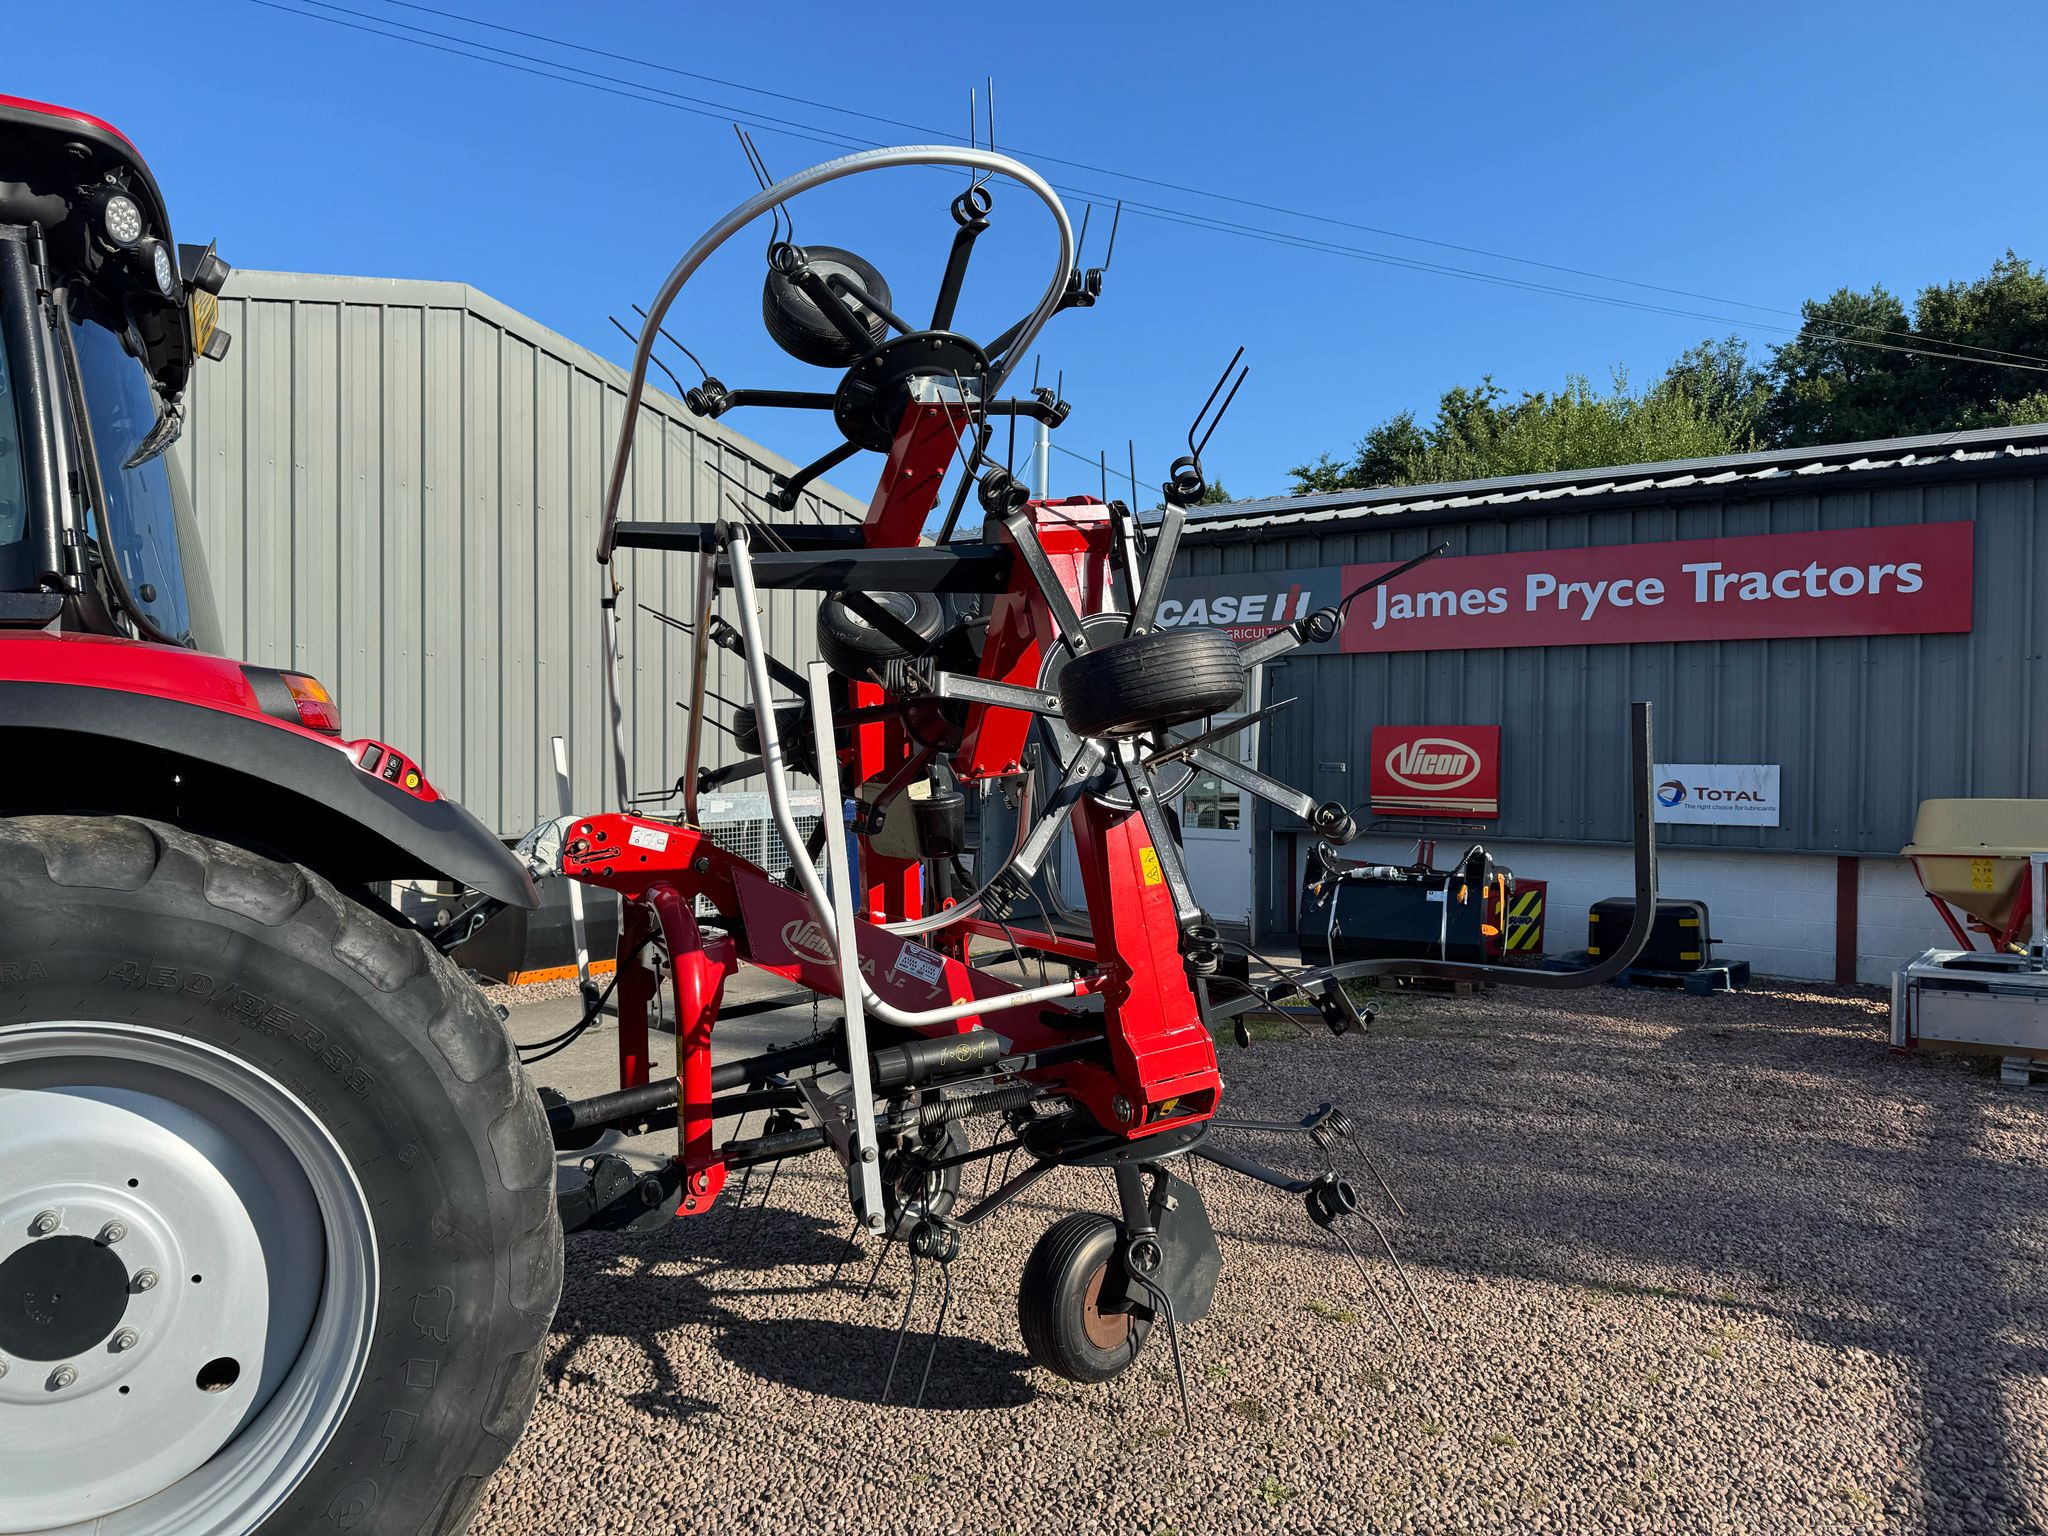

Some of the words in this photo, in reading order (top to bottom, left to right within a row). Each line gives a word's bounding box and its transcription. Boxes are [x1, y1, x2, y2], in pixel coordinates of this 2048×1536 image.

[1155, 594, 1268, 627] CASE
[1372, 584, 1508, 630] James
[1525, 573, 1665, 621] Pryce
[1681, 560, 1924, 603] Tractors
[1396, 740, 1471, 779] Vicon
